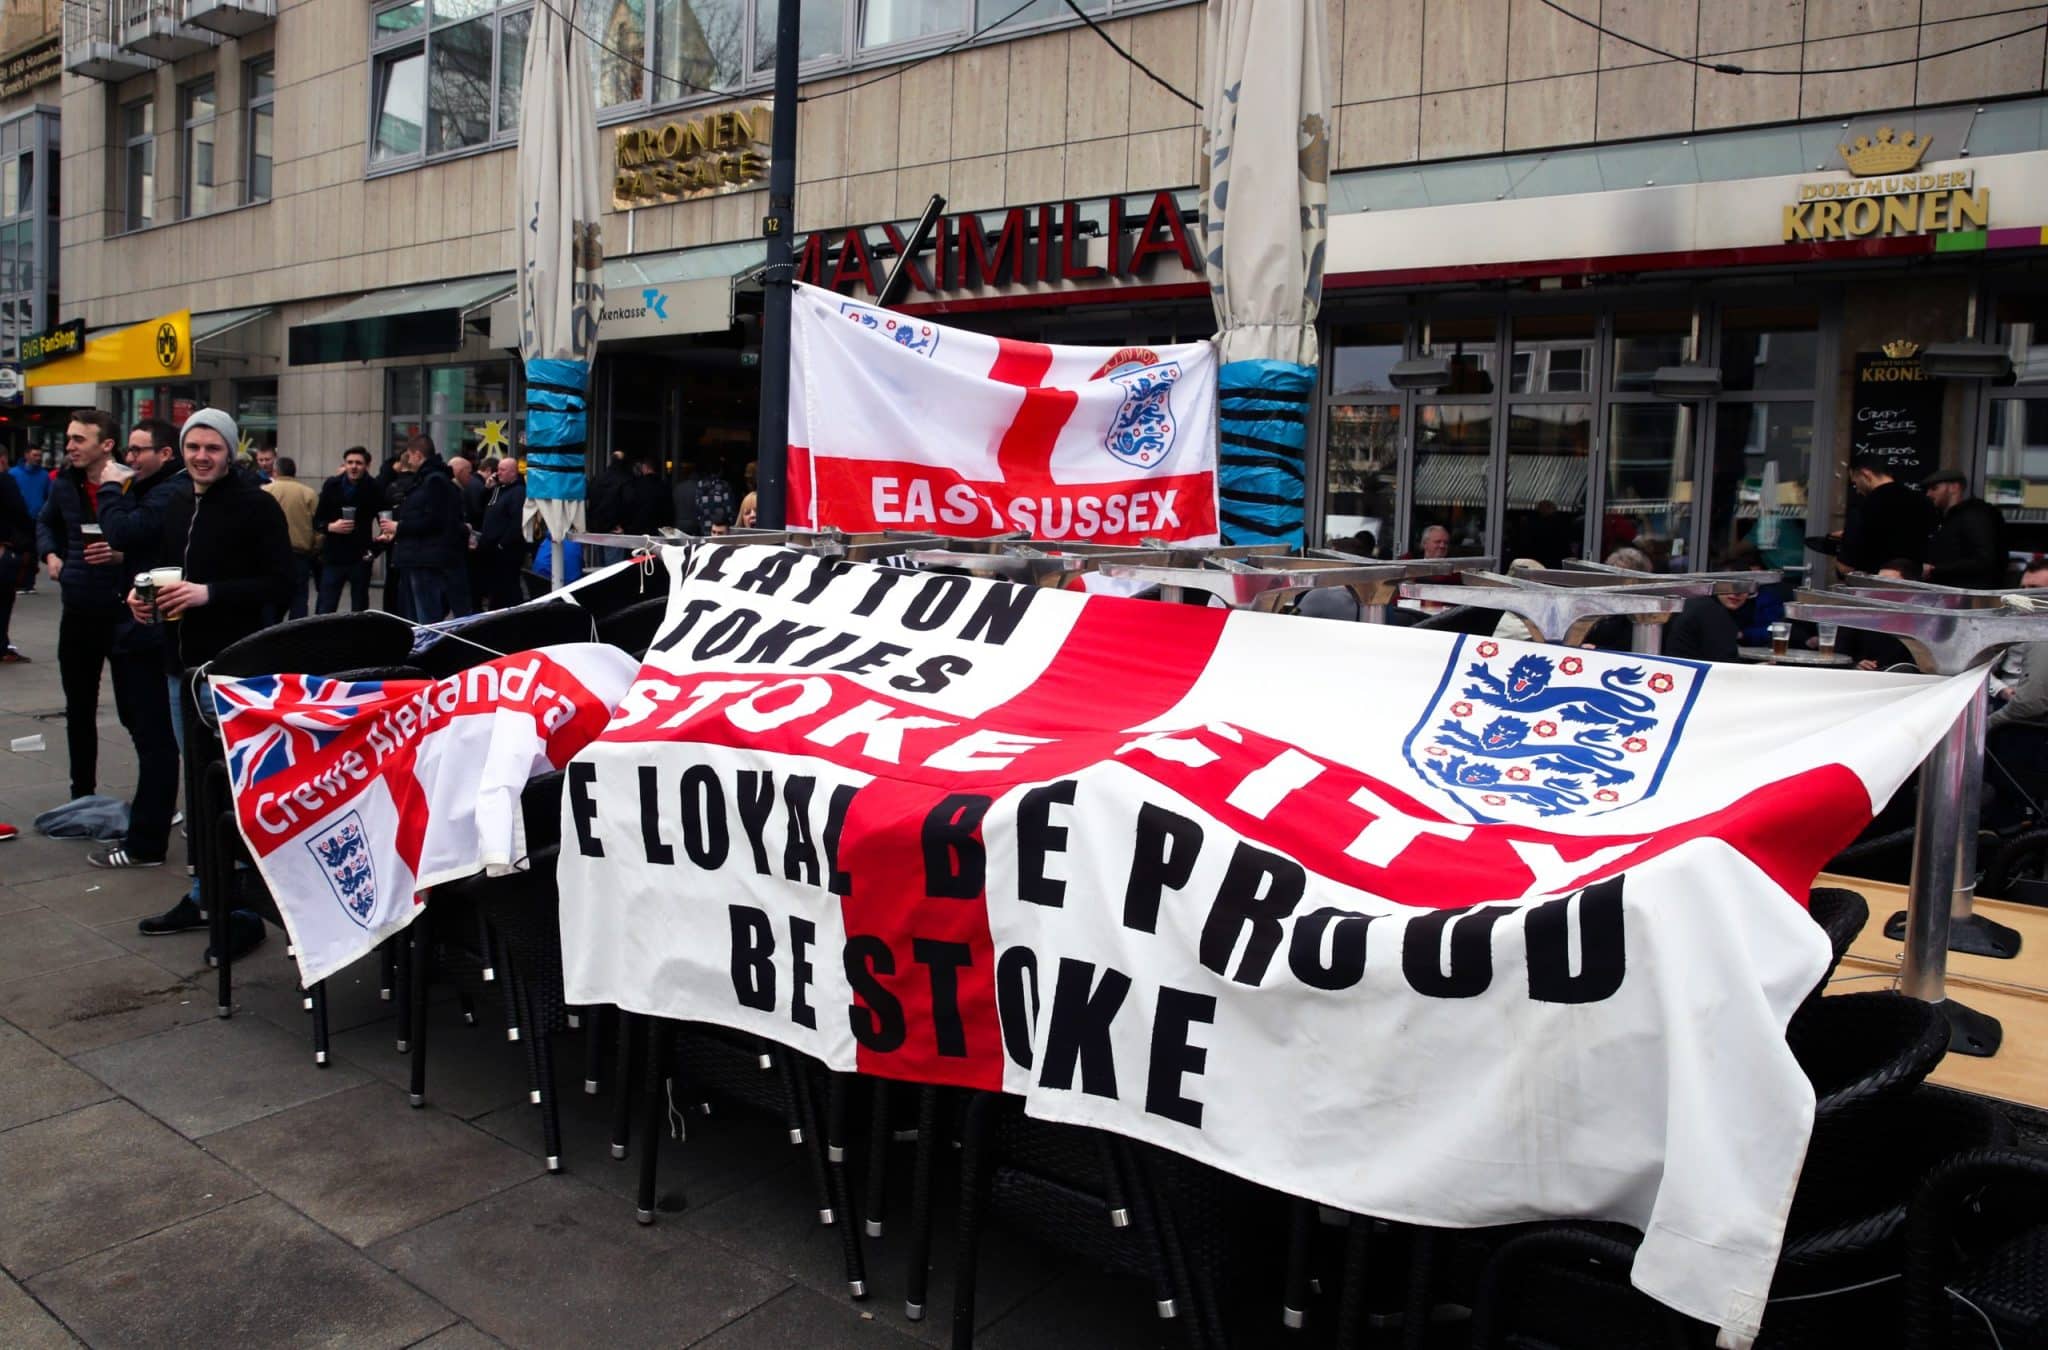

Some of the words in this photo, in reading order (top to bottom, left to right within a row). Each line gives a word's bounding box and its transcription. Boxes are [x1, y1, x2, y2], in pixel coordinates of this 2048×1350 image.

[616, 106, 760, 168] KRONEN
[615, 151, 757, 196] PASSAGE
[1802, 171, 1967, 201] DORTMUNDER
[767, 218, 779, 232] 12
[1783, 187, 1990, 241] KRONEN
[22, 337, 39, 361] BVB
[40, 330, 76, 356] FanShop
[1861, 366, 1929, 383] KRONE
[1008, 488, 1182, 539] SUSSEX
[651, 600, 973, 695] TOKIES
[255, 749, 369, 835] Crewe
[365, 658, 577, 764] Alexandra
[603, 676, 1063, 773] STOKE
[638, 763, 860, 897] LOYAL
[919, 780, 1079, 910] BE
[1123, 801, 1627, 1005] PROUD
[729, 903, 818, 1031] BE
[842, 935, 1218, 1130] STOKE
